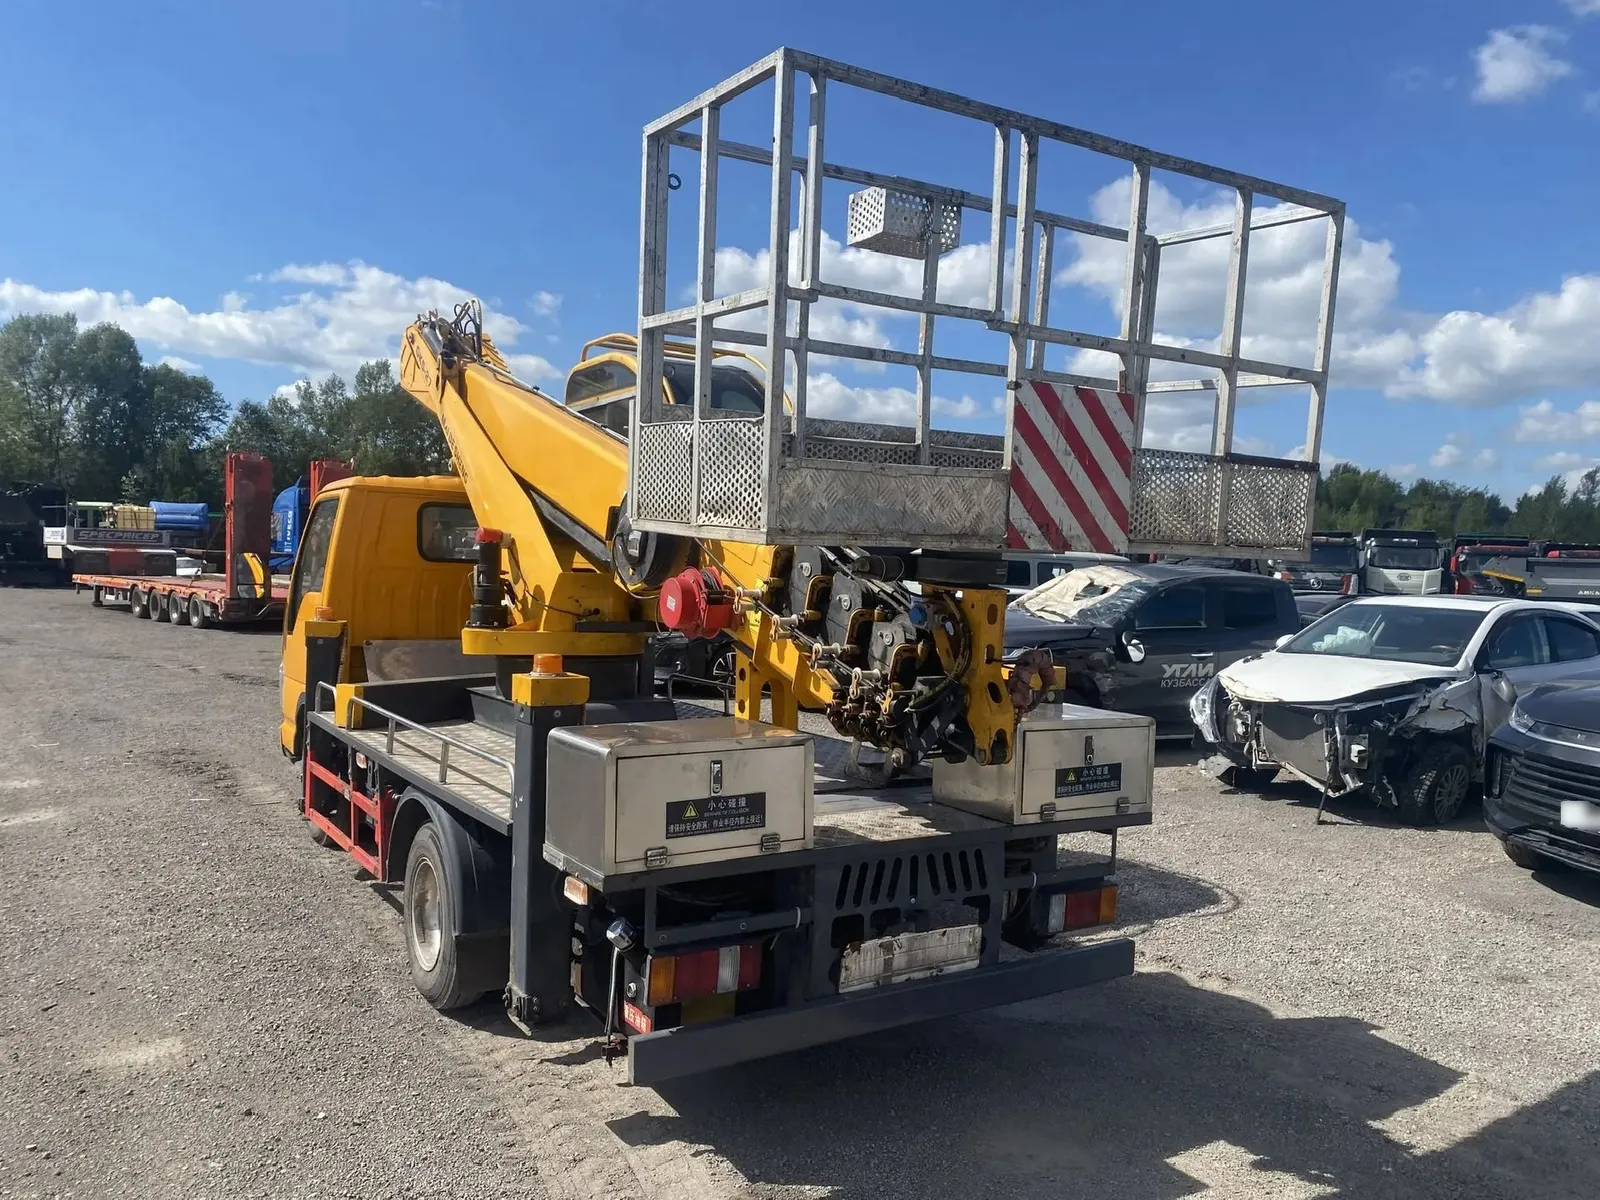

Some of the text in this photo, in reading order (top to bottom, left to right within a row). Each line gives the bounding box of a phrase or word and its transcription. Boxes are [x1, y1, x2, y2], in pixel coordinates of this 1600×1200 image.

[286, 510, 294, 541] IVECO
[1161, 663, 1214, 678] УГЛИ
[707, 797, 747, 811] 小心碰撞
